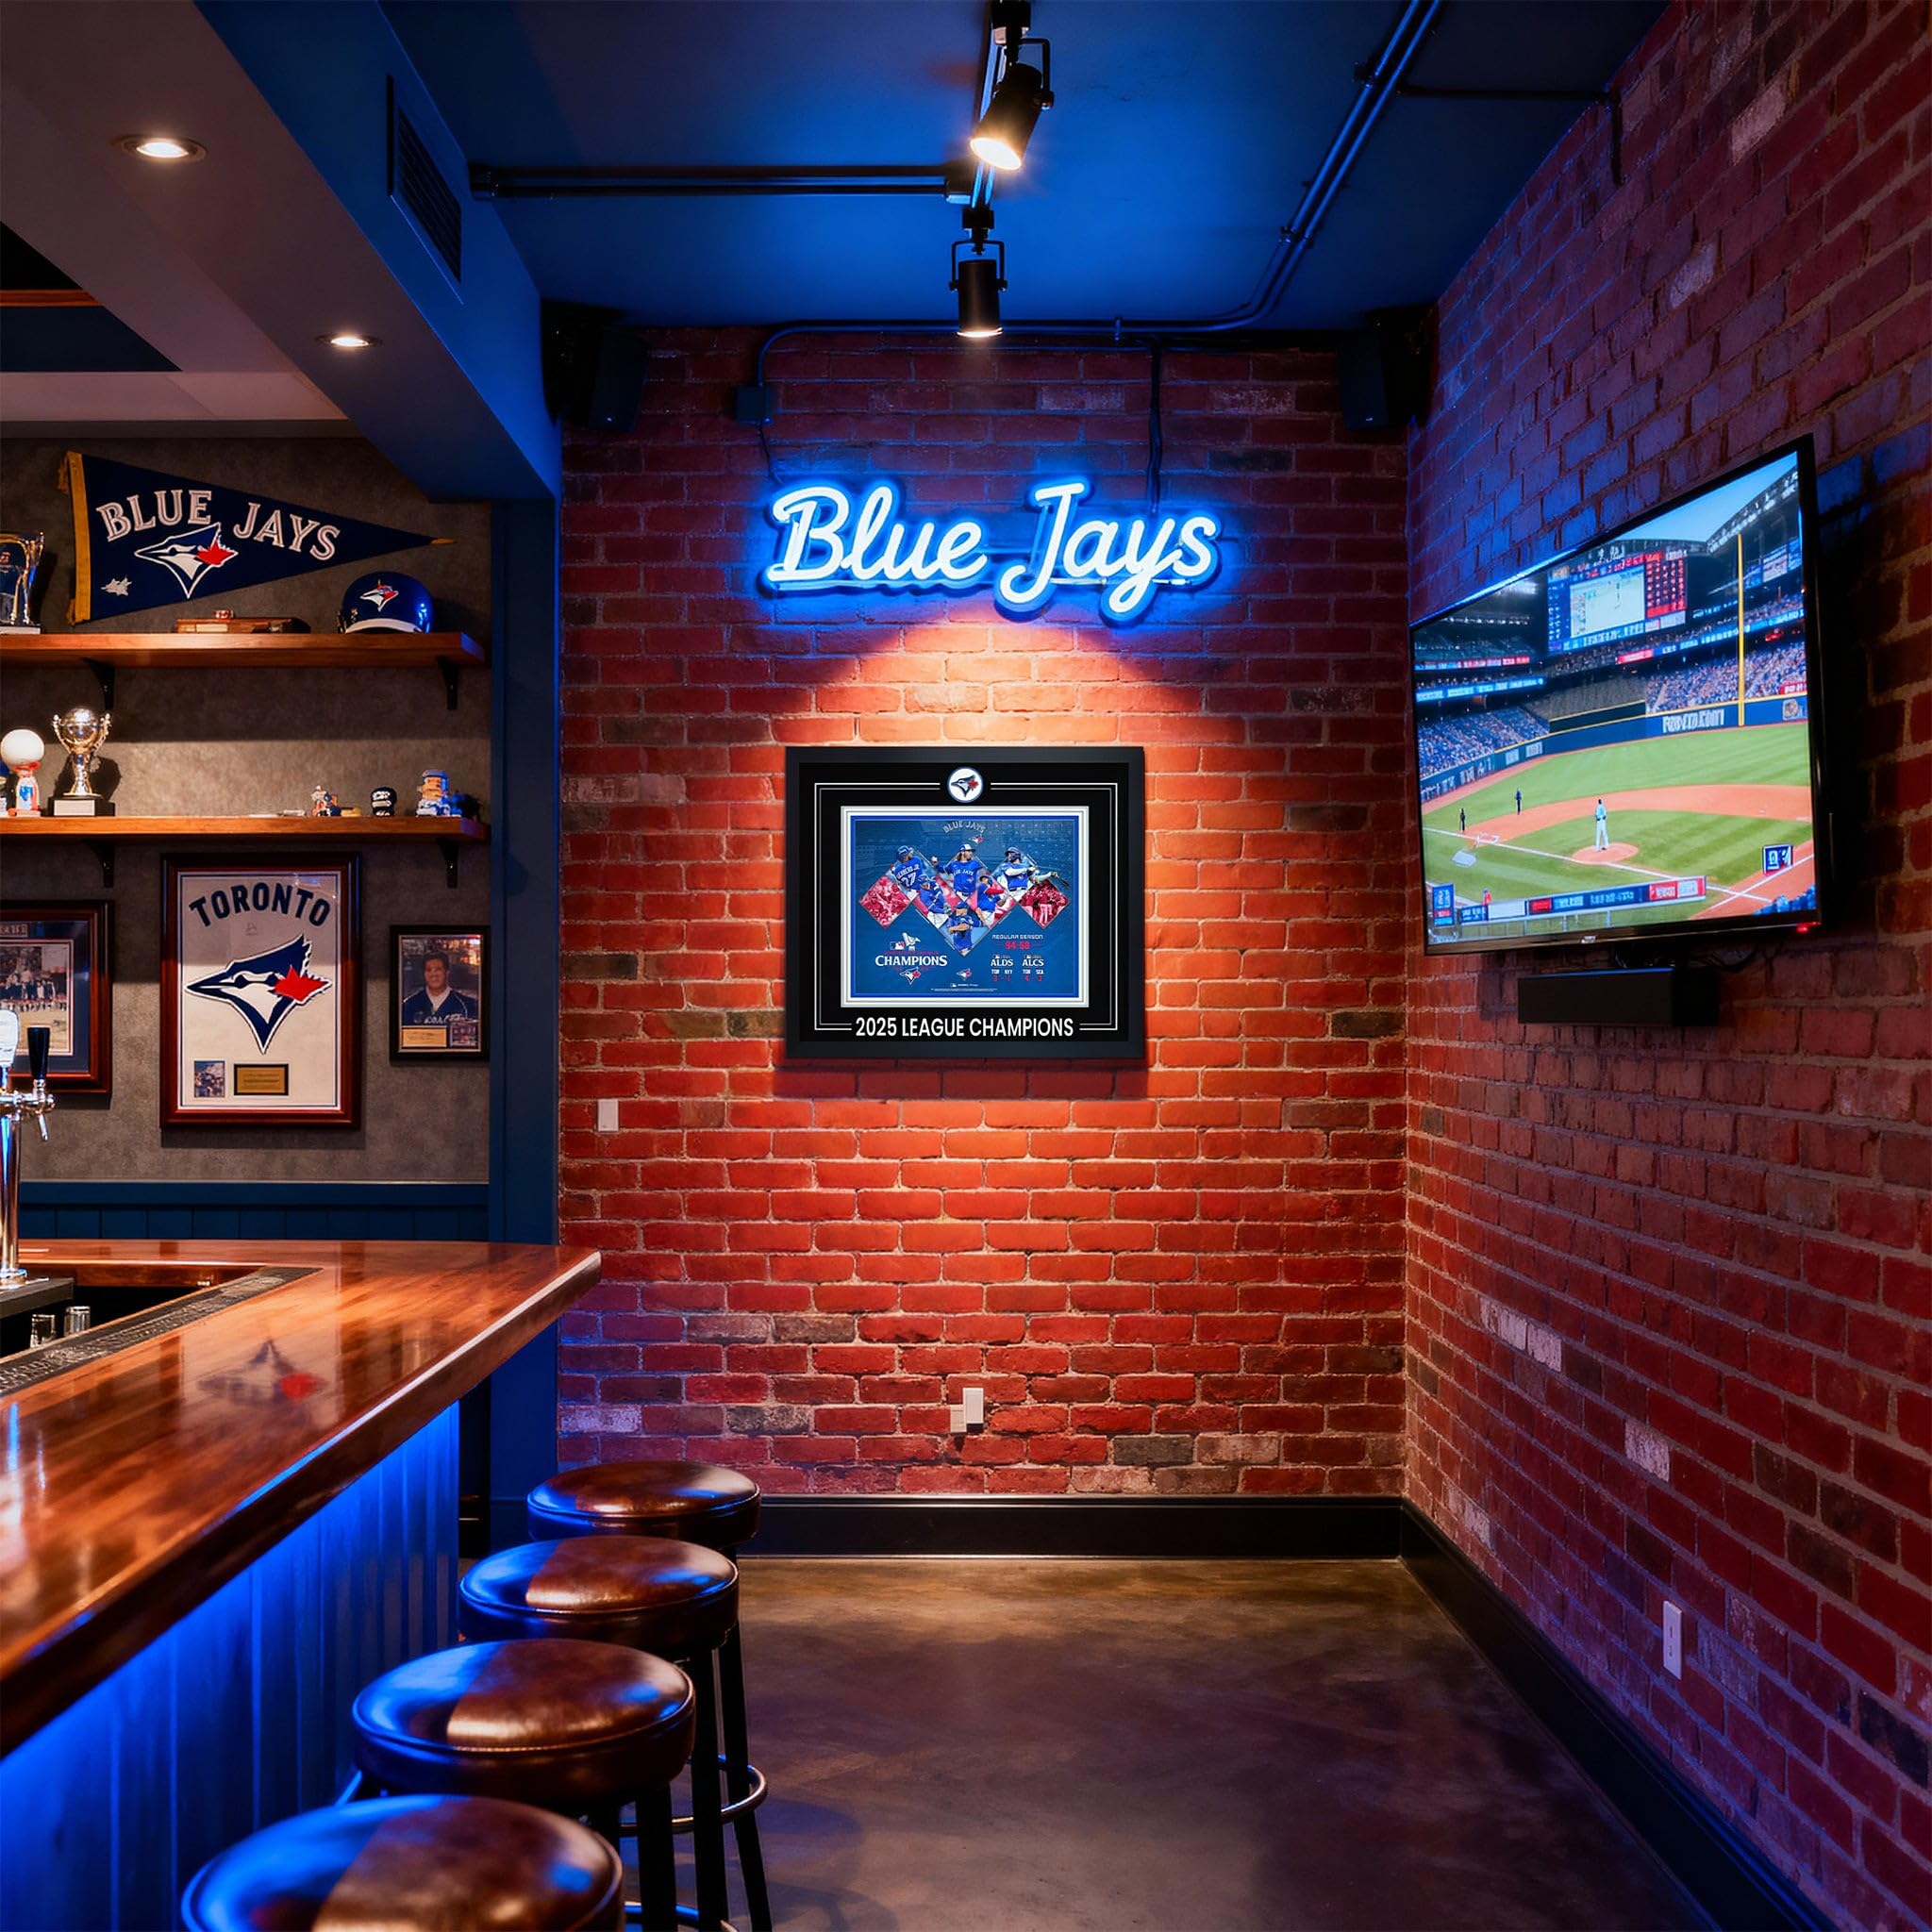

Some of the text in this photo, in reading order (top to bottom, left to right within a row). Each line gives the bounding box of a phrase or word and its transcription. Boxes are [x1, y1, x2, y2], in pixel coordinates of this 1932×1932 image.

[95, 489, 341, 560] BLUE JAYS
[766, 482, 1218, 614] Blue Jays
[942, 820, 986, 834] BLUE JAYS
[189, 882, 331, 927] TORONTO
[874, 955, 948, 967] CHAMPIONS
[991, 958, 1014, 967] ALDS
[1022, 958, 1044, 967] ALCS
[856, 1017, 1074, 1036] 2025 LEAGUE CHAMPIONS
